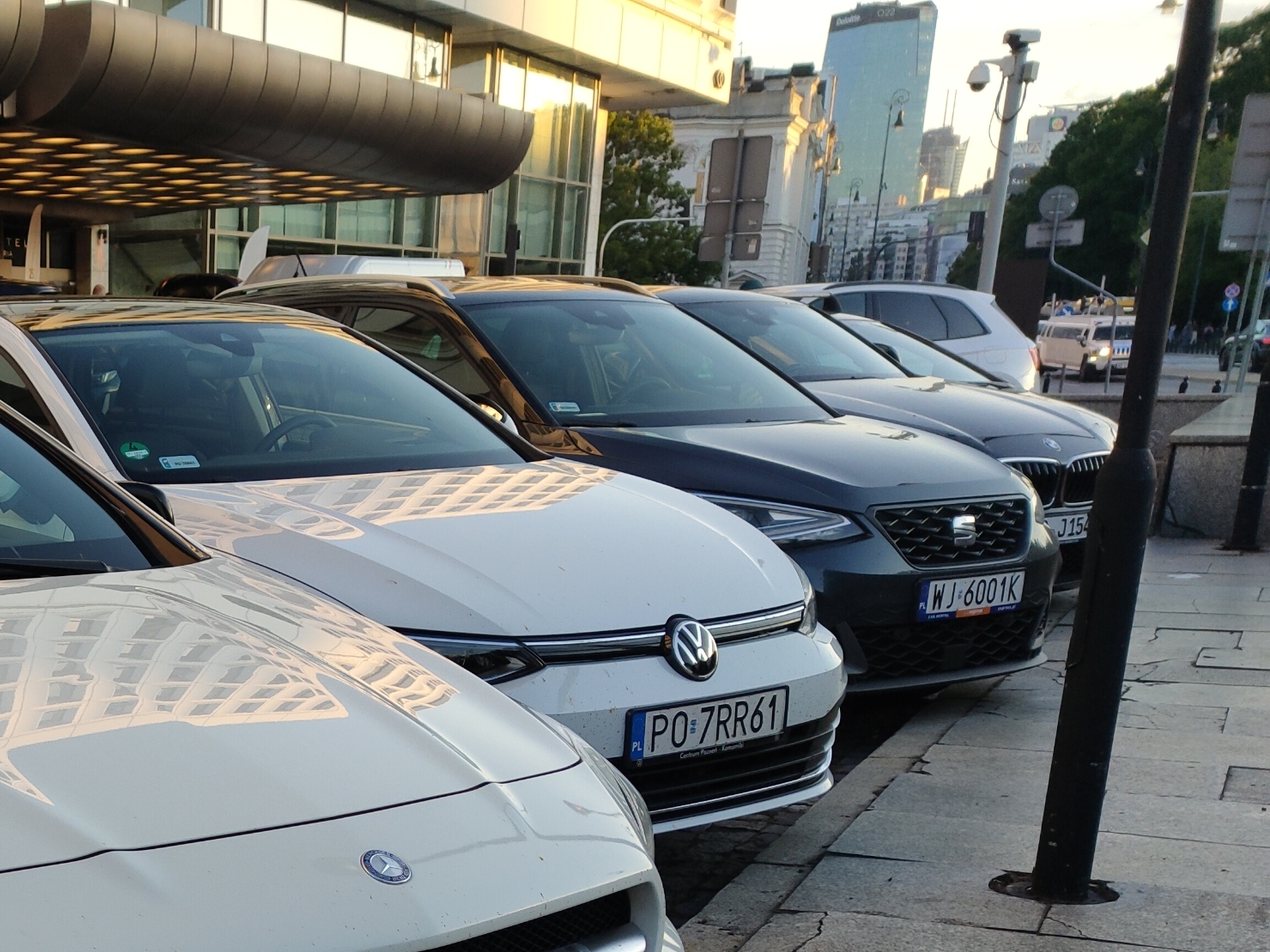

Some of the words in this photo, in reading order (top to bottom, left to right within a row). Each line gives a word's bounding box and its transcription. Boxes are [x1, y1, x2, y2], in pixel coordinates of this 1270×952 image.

[932, 581, 957, 611] WJ
[963, 574, 1021, 607] 6001K
[650, 710, 689, 753] PO
[698, 694, 778, 745] 7RR61
[631, 741, 642, 752] PL
